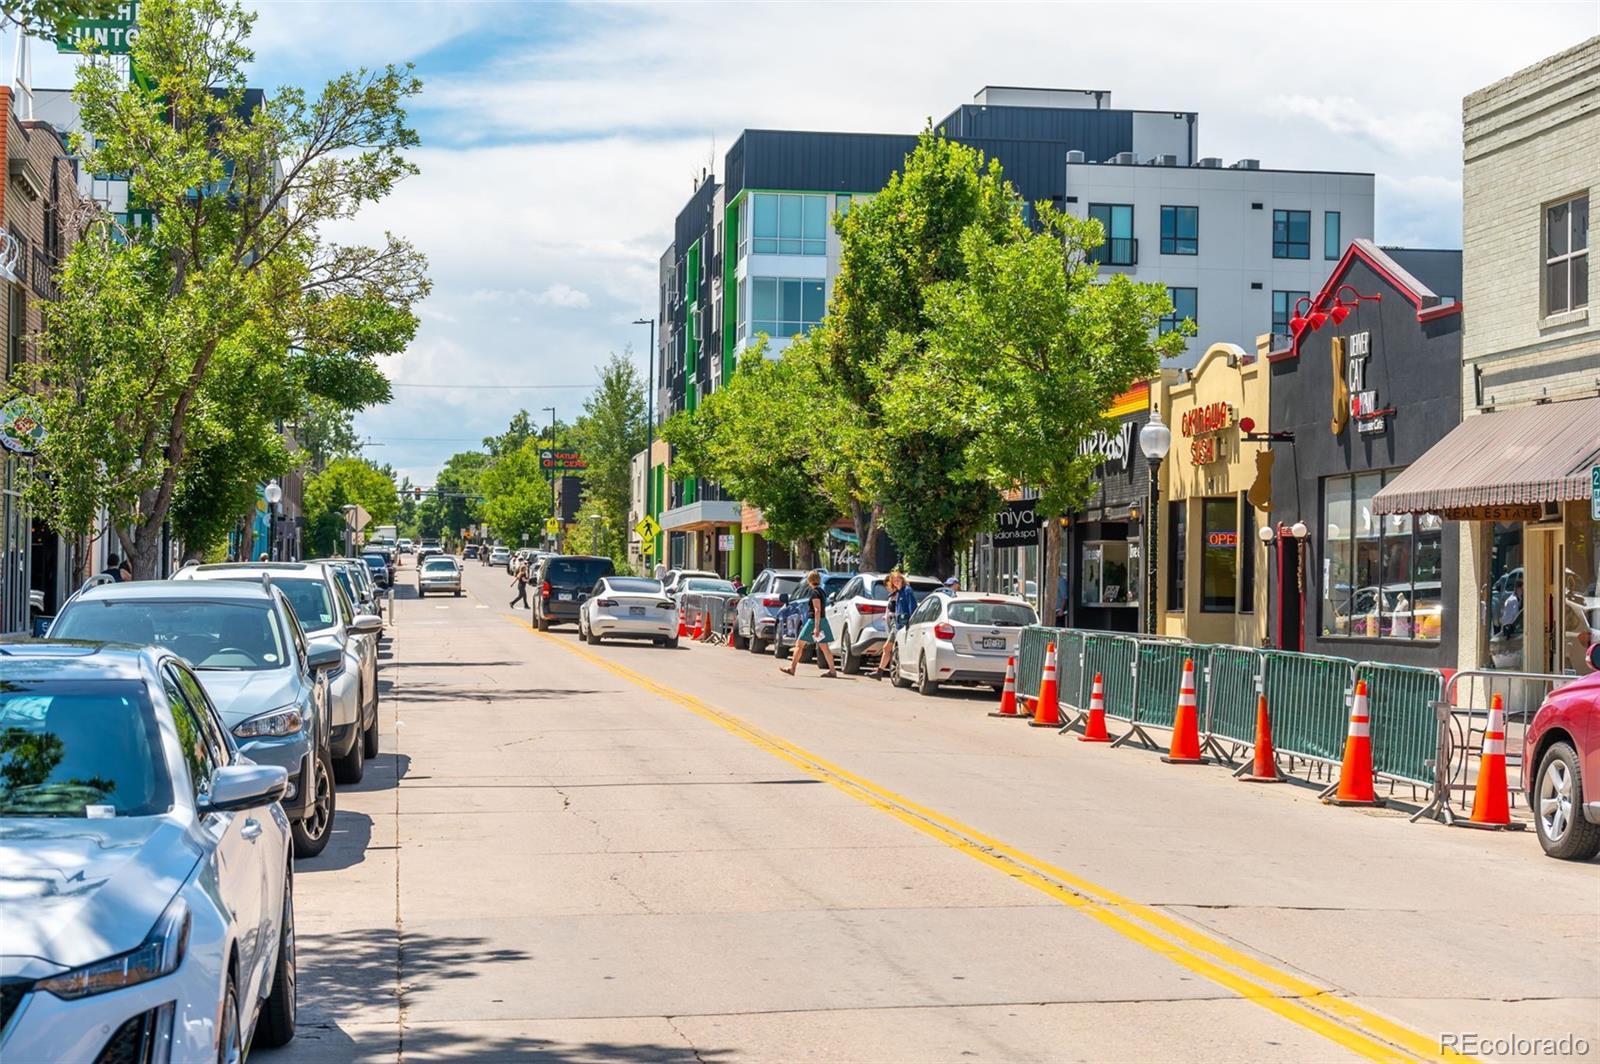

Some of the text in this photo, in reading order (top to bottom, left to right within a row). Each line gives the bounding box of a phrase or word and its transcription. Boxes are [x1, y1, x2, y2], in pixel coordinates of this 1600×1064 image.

[1349, 358, 1364, 393] CAT
[994, 507, 1035, 528] miya
[1485, 506, 1540, 519] ESTATE
